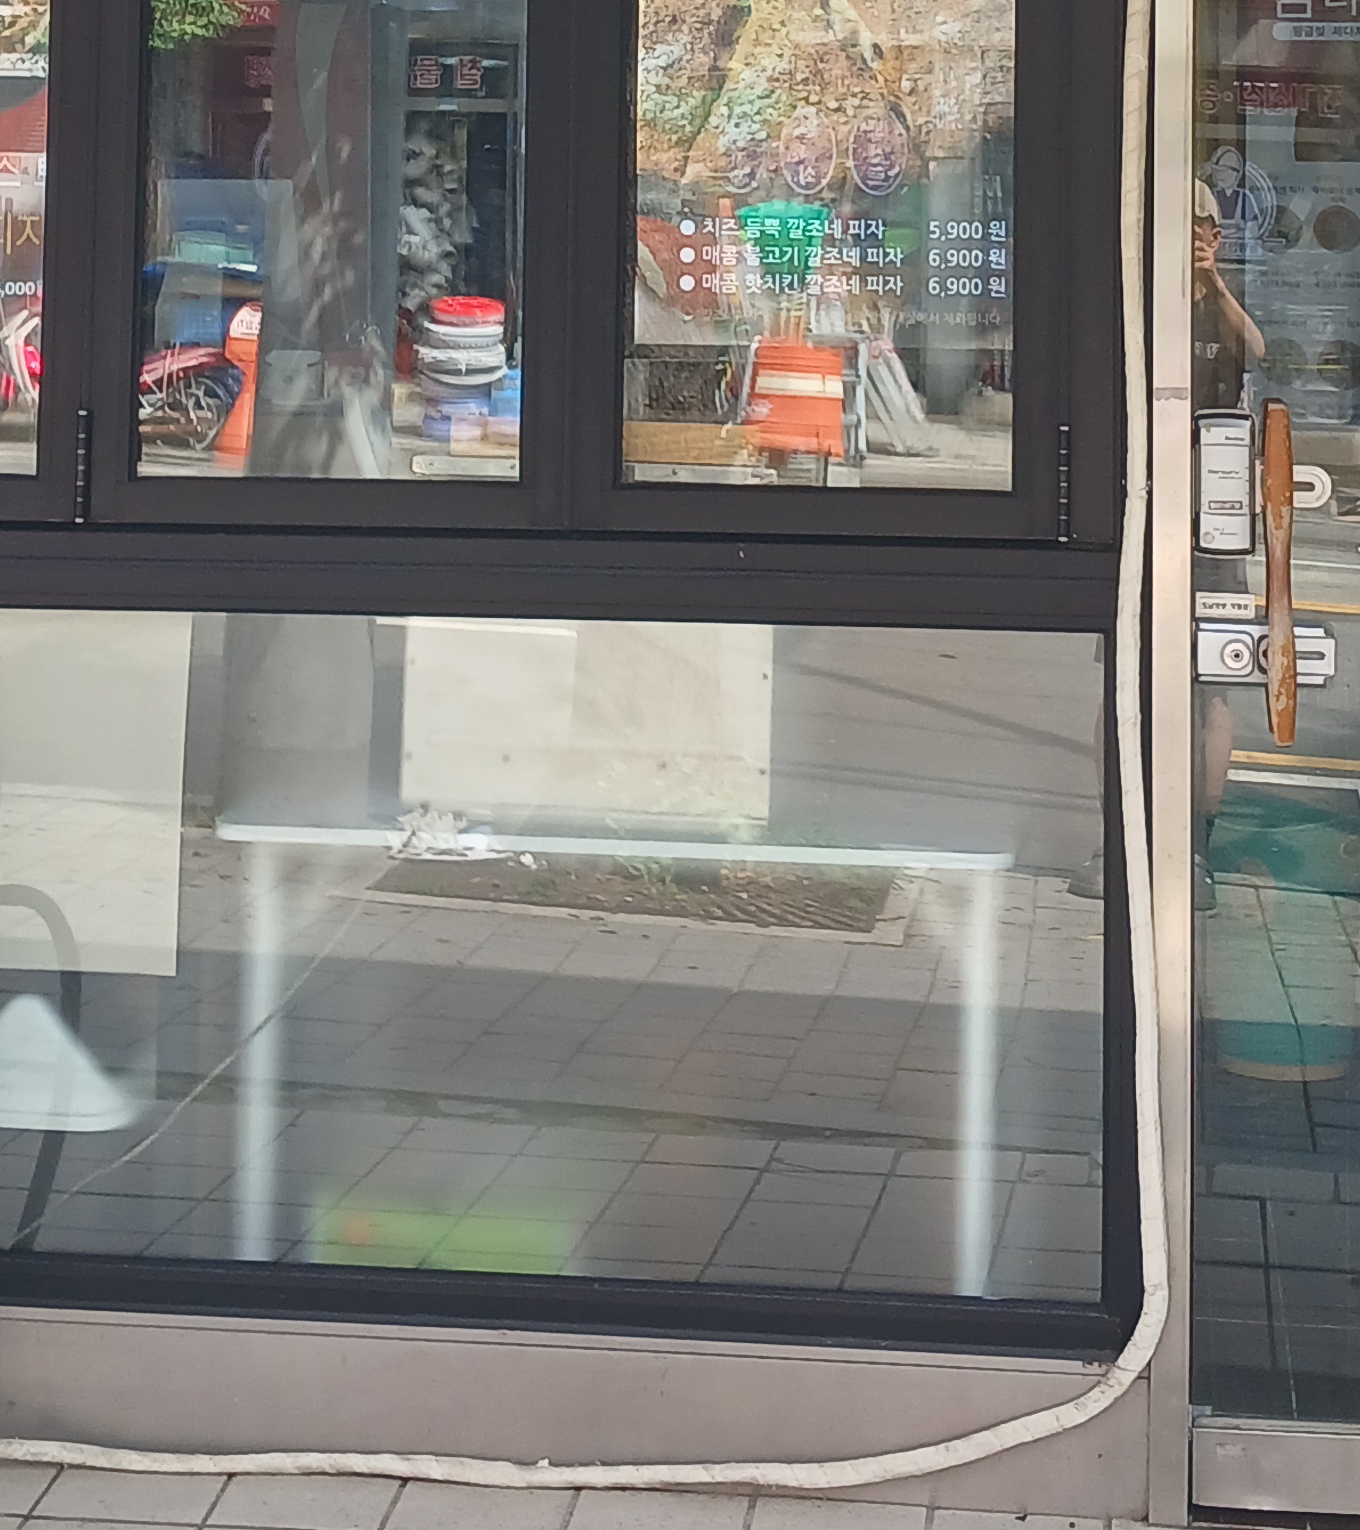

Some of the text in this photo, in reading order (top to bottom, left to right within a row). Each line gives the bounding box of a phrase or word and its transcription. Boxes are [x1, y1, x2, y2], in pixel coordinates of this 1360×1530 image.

[701, 218, 740, 238] 치즈
[847, 218, 887, 240] 피자
[928, 220, 983, 242] 5,900
[987, 220, 1007, 242] 원
[701, 245, 740, 266] 매콤
[744, 245, 799, 267] 불고기
[866, 247, 904, 269] 피자
[928, 248, 983, 271] 6,900
[987, 248, 1007, 270] 원
[701, 274, 740, 296] 매콤
[744, 274, 799, 297] 핫치킨
[866, 275, 904, 297] 피자
[928, 276, 983, 301] 6,900
[987, 276, 1007, 298] 원
